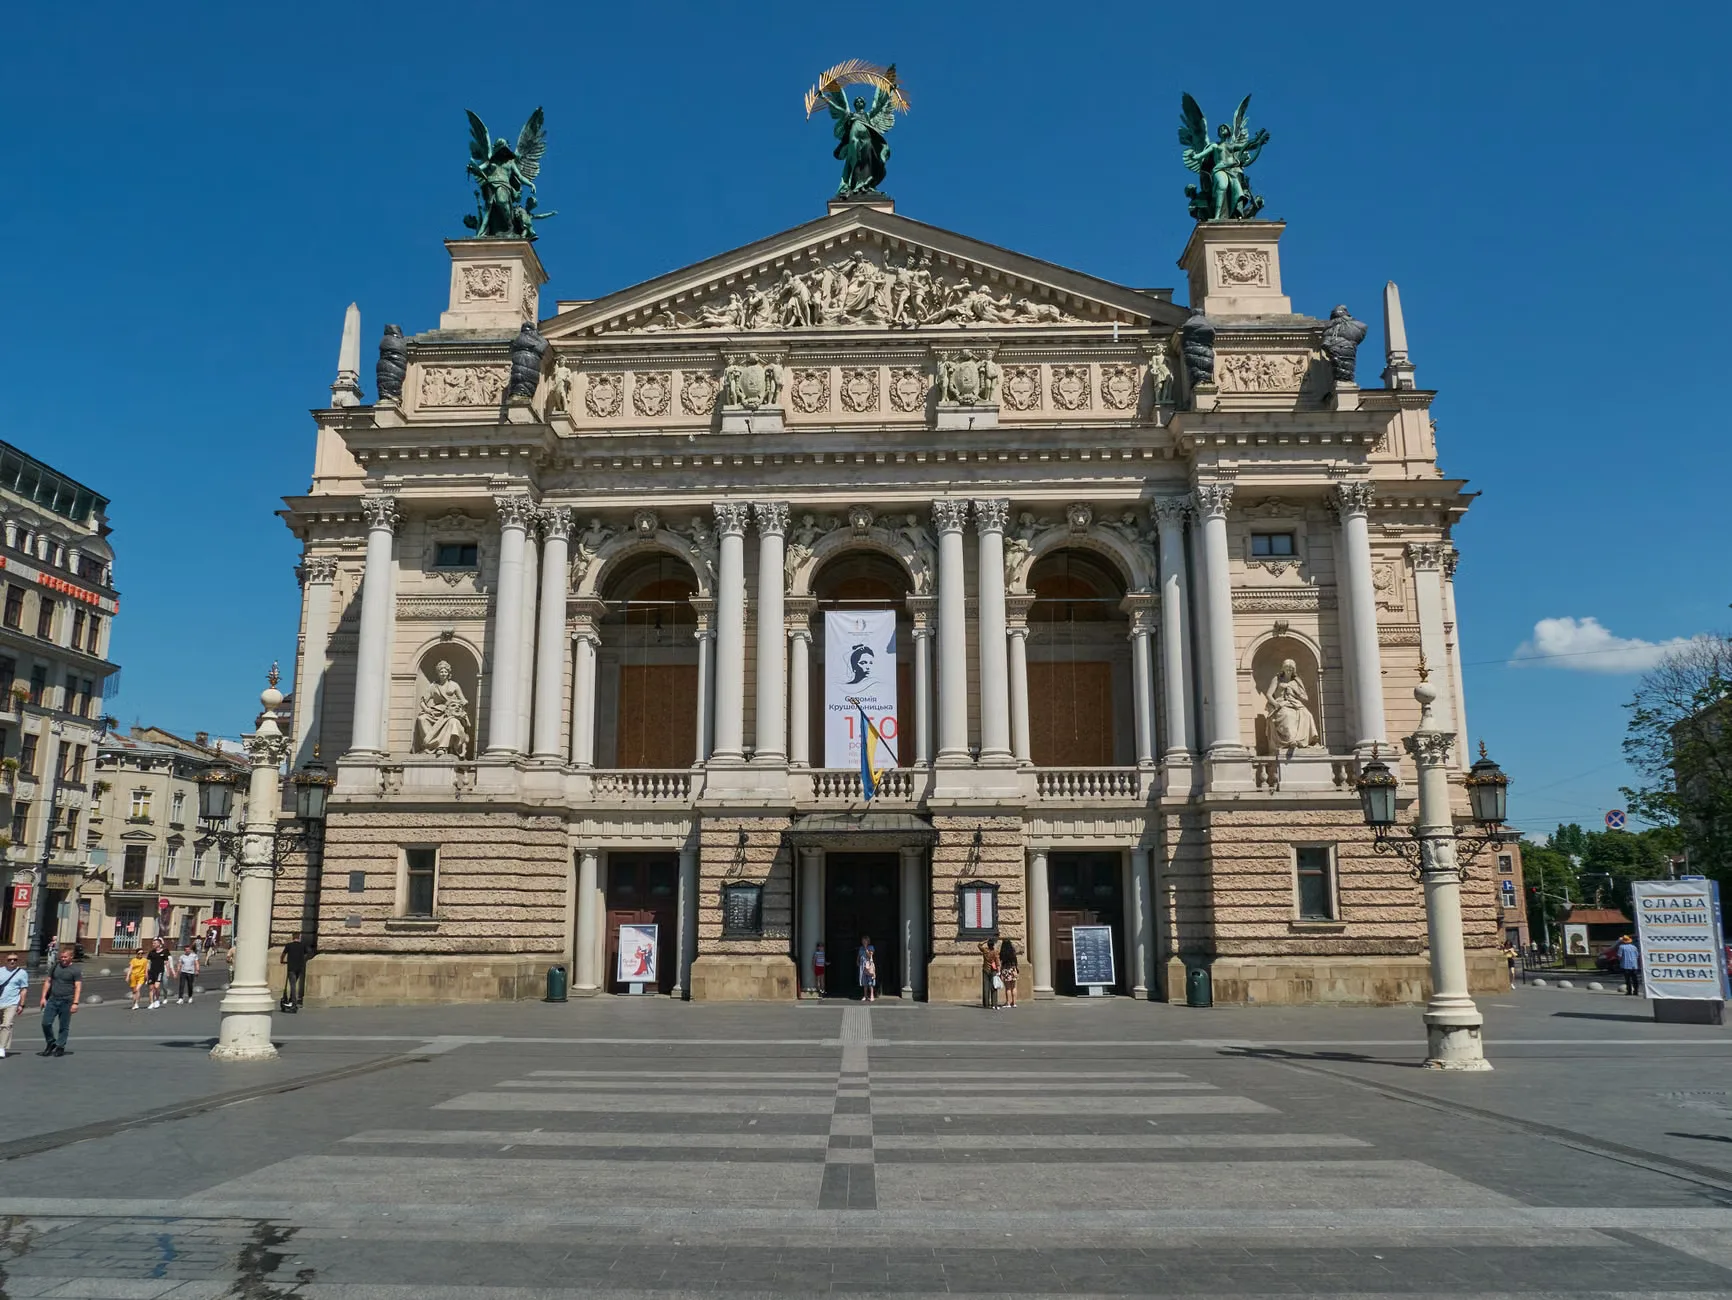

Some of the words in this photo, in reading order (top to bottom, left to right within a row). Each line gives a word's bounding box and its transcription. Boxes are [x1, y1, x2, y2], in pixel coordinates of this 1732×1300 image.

[844, 716, 899, 739] 10
[18, 889, 28, 900] R
[1642, 899, 1706, 909] СЛАВА
[1644, 911, 1708, 924] УКРАЇНІ!
[1649, 953, 1711, 963] ГЕРОЯМ
[1651, 968, 1714, 979] СЛАВА!
